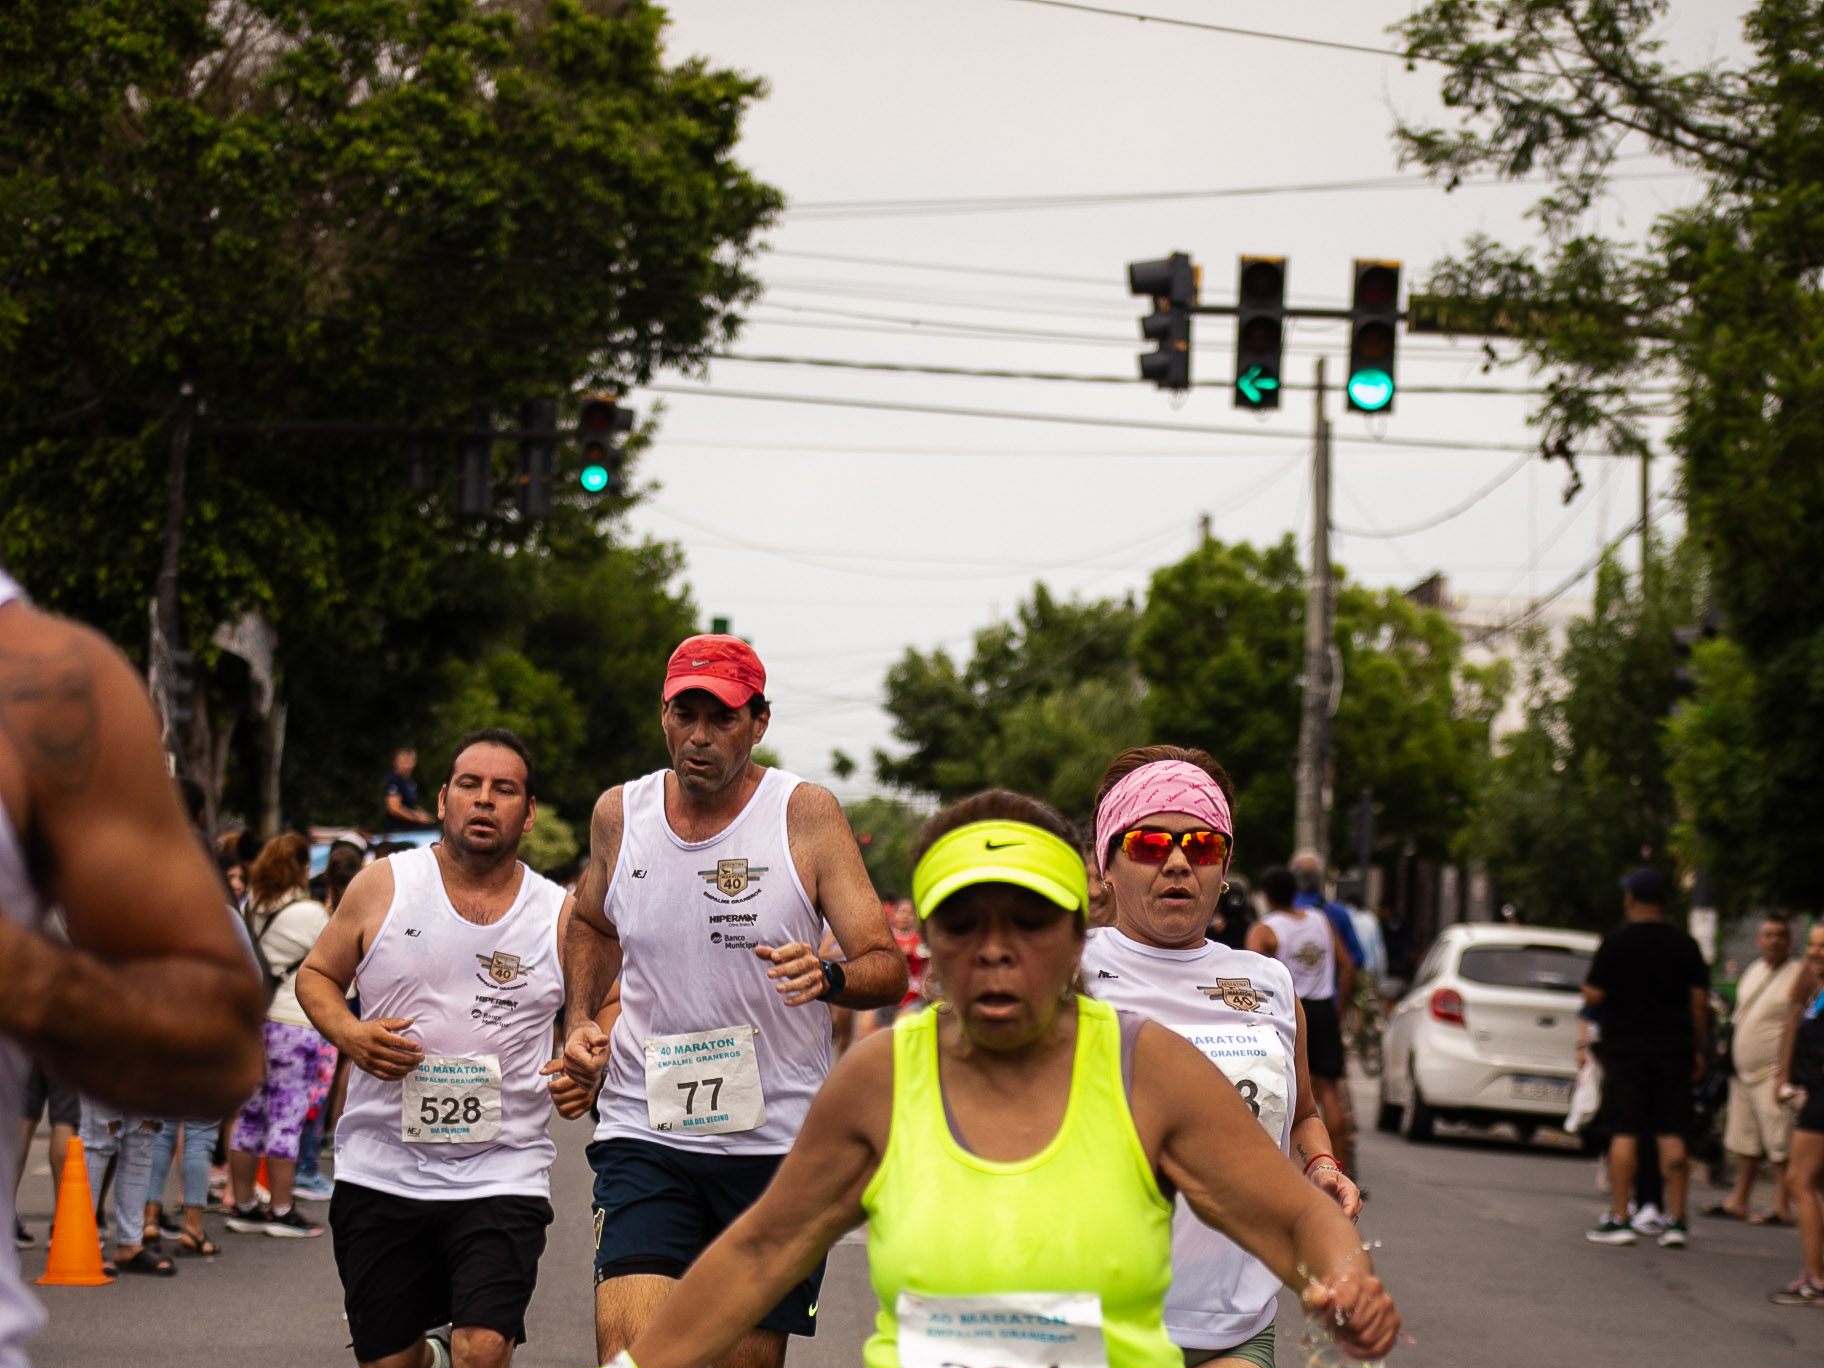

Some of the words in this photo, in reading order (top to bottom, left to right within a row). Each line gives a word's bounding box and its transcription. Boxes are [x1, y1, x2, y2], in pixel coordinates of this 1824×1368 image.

[632, 869, 647, 879] NEJ
[723, 878, 741, 889] 40
[405, 928, 421, 937] NEJ
[724, 934, 746, 942] Banco
[725, 940, 759, 950] Municipal
[495, 969, 511, 979] 40
[1232, 995, 1253, 1006] 40
[660, 1046, 671, 1056] 40
[674, 1037, 735, 1055] MARATON
[1210, 1049, 1268, 1058] GRANEROS
[658, 1057, 694, 1068] EMPALME
[695, 1050, 741, 1063] GRANEROS
[418, 1064, 430, 1073] 40
[433, 1066, 486, 1074] MARATON
[414, 1075, 448, 1084] EMPALME
[450, 1077, 490, 1085] GRANEROS
[676, 1077, 724, 1115] 77
[420, 1096, 482, 1125] 528
[407, 1127, 422, 1136] NEJ
[657, 1122, 673, 1132] NEJ
[959, 1312, 1068, 1327] MARATON
